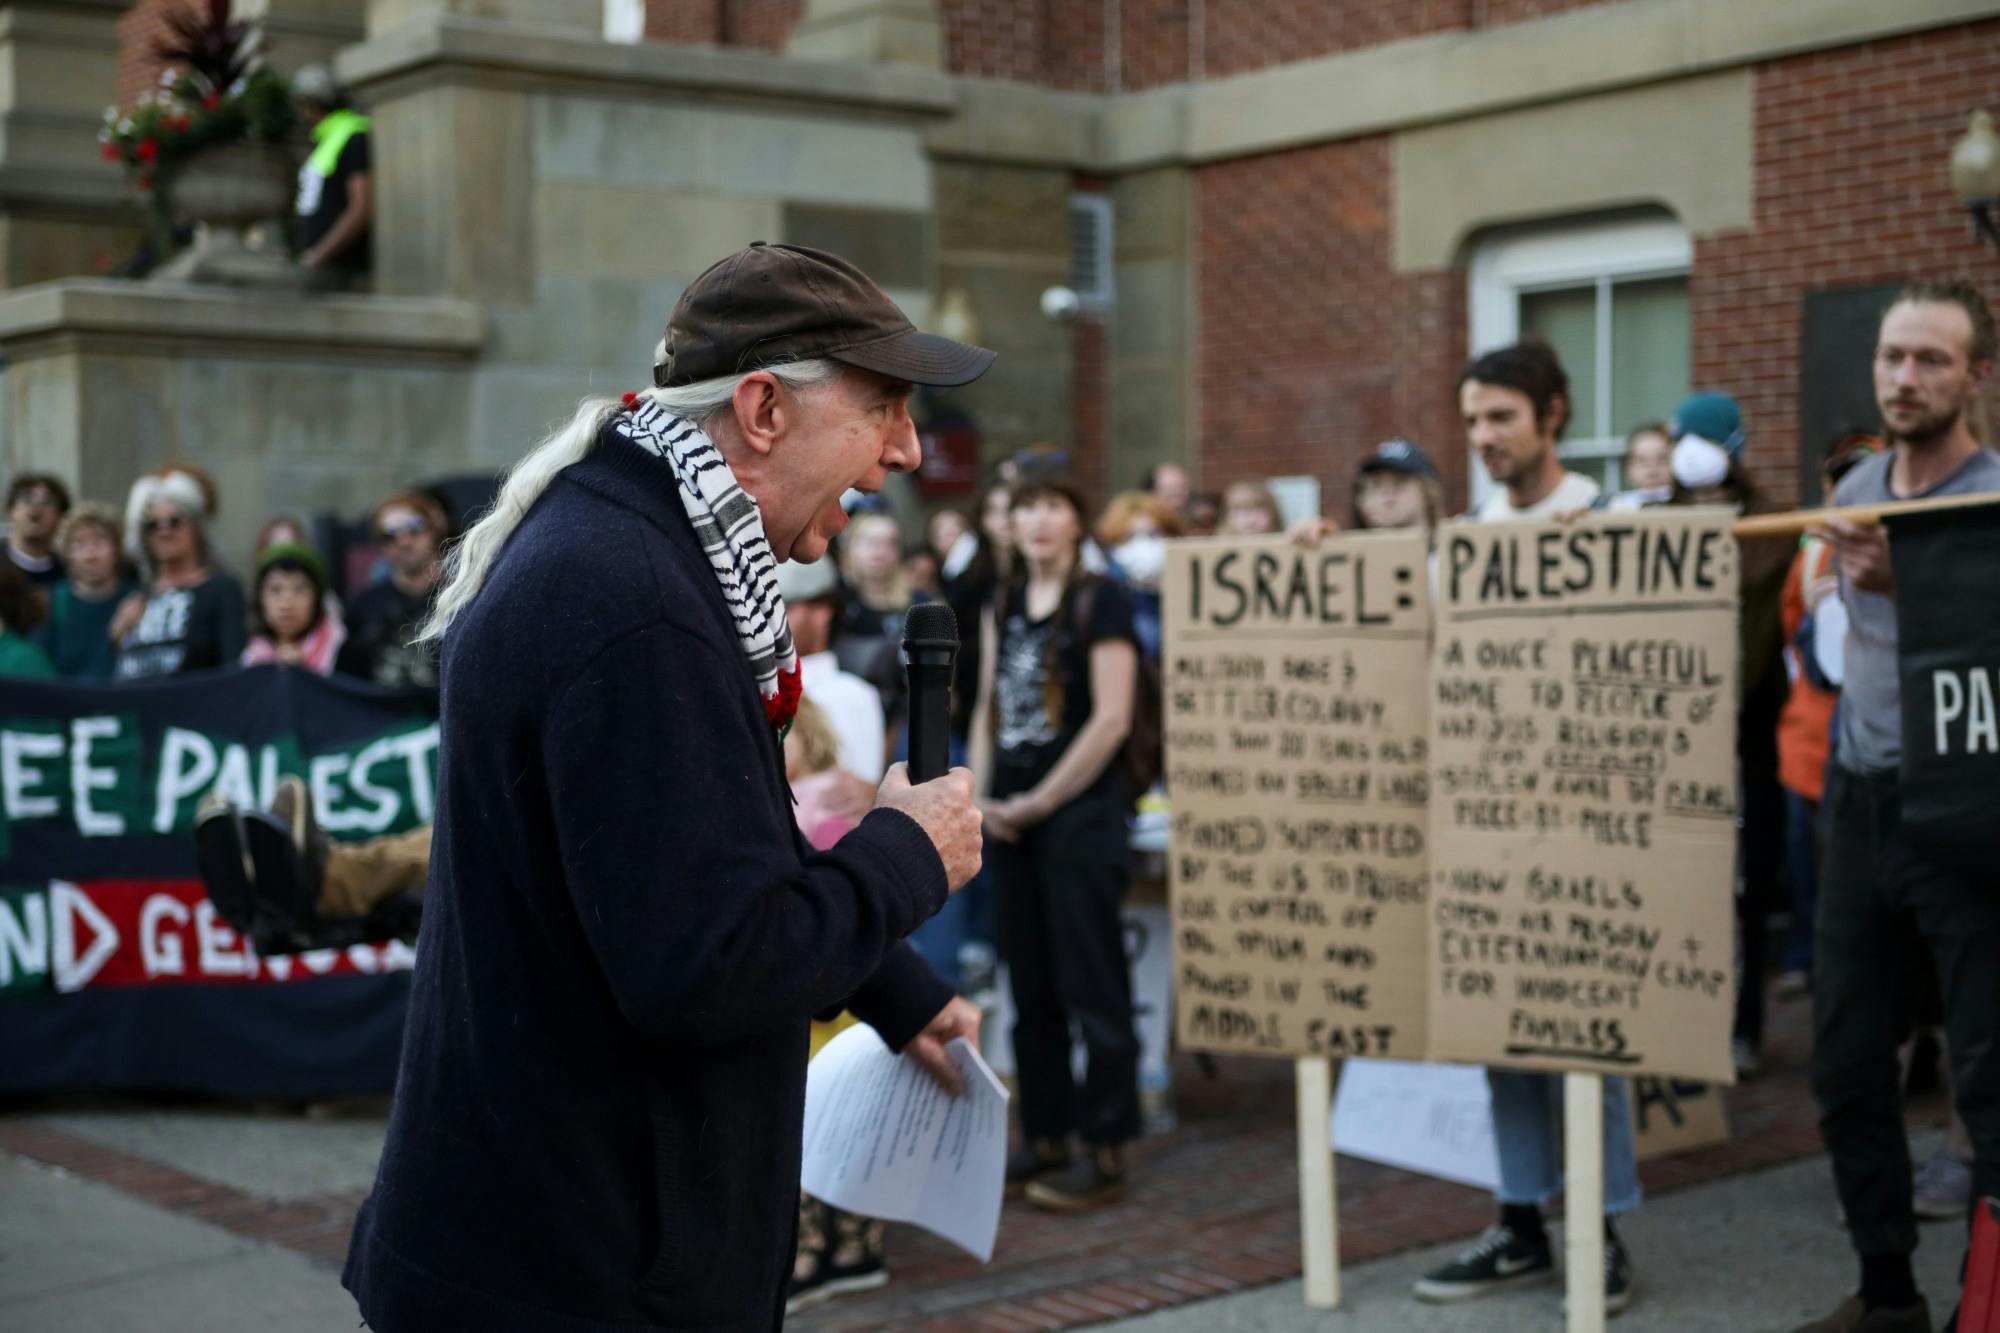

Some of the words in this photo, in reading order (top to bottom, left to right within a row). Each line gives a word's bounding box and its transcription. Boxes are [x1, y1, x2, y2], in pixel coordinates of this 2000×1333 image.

[1449, 526, 1732, 603] PALESTINE:
[1190, 552, 1413, 626] ISRAEL:
[1444, 638, 1464, 665] A
[1476, 639, 1549, 670] ONCE
[1572, 638, 1722, 687] PEACEFUL
[1437, 677, 1500, 712] HOME
[1530, 680, 1564, 712] TO
[1575, 684, 1671, 721] PEOPLE
[1686, 690, 1722, 725] OF
[1932, 667, 2000, 756] PA
[1567, 911, 1662, 952] PRISON
[1440, 966, 1497, 999] FOR
[1305, 1017, 1396, 1054] EAST
